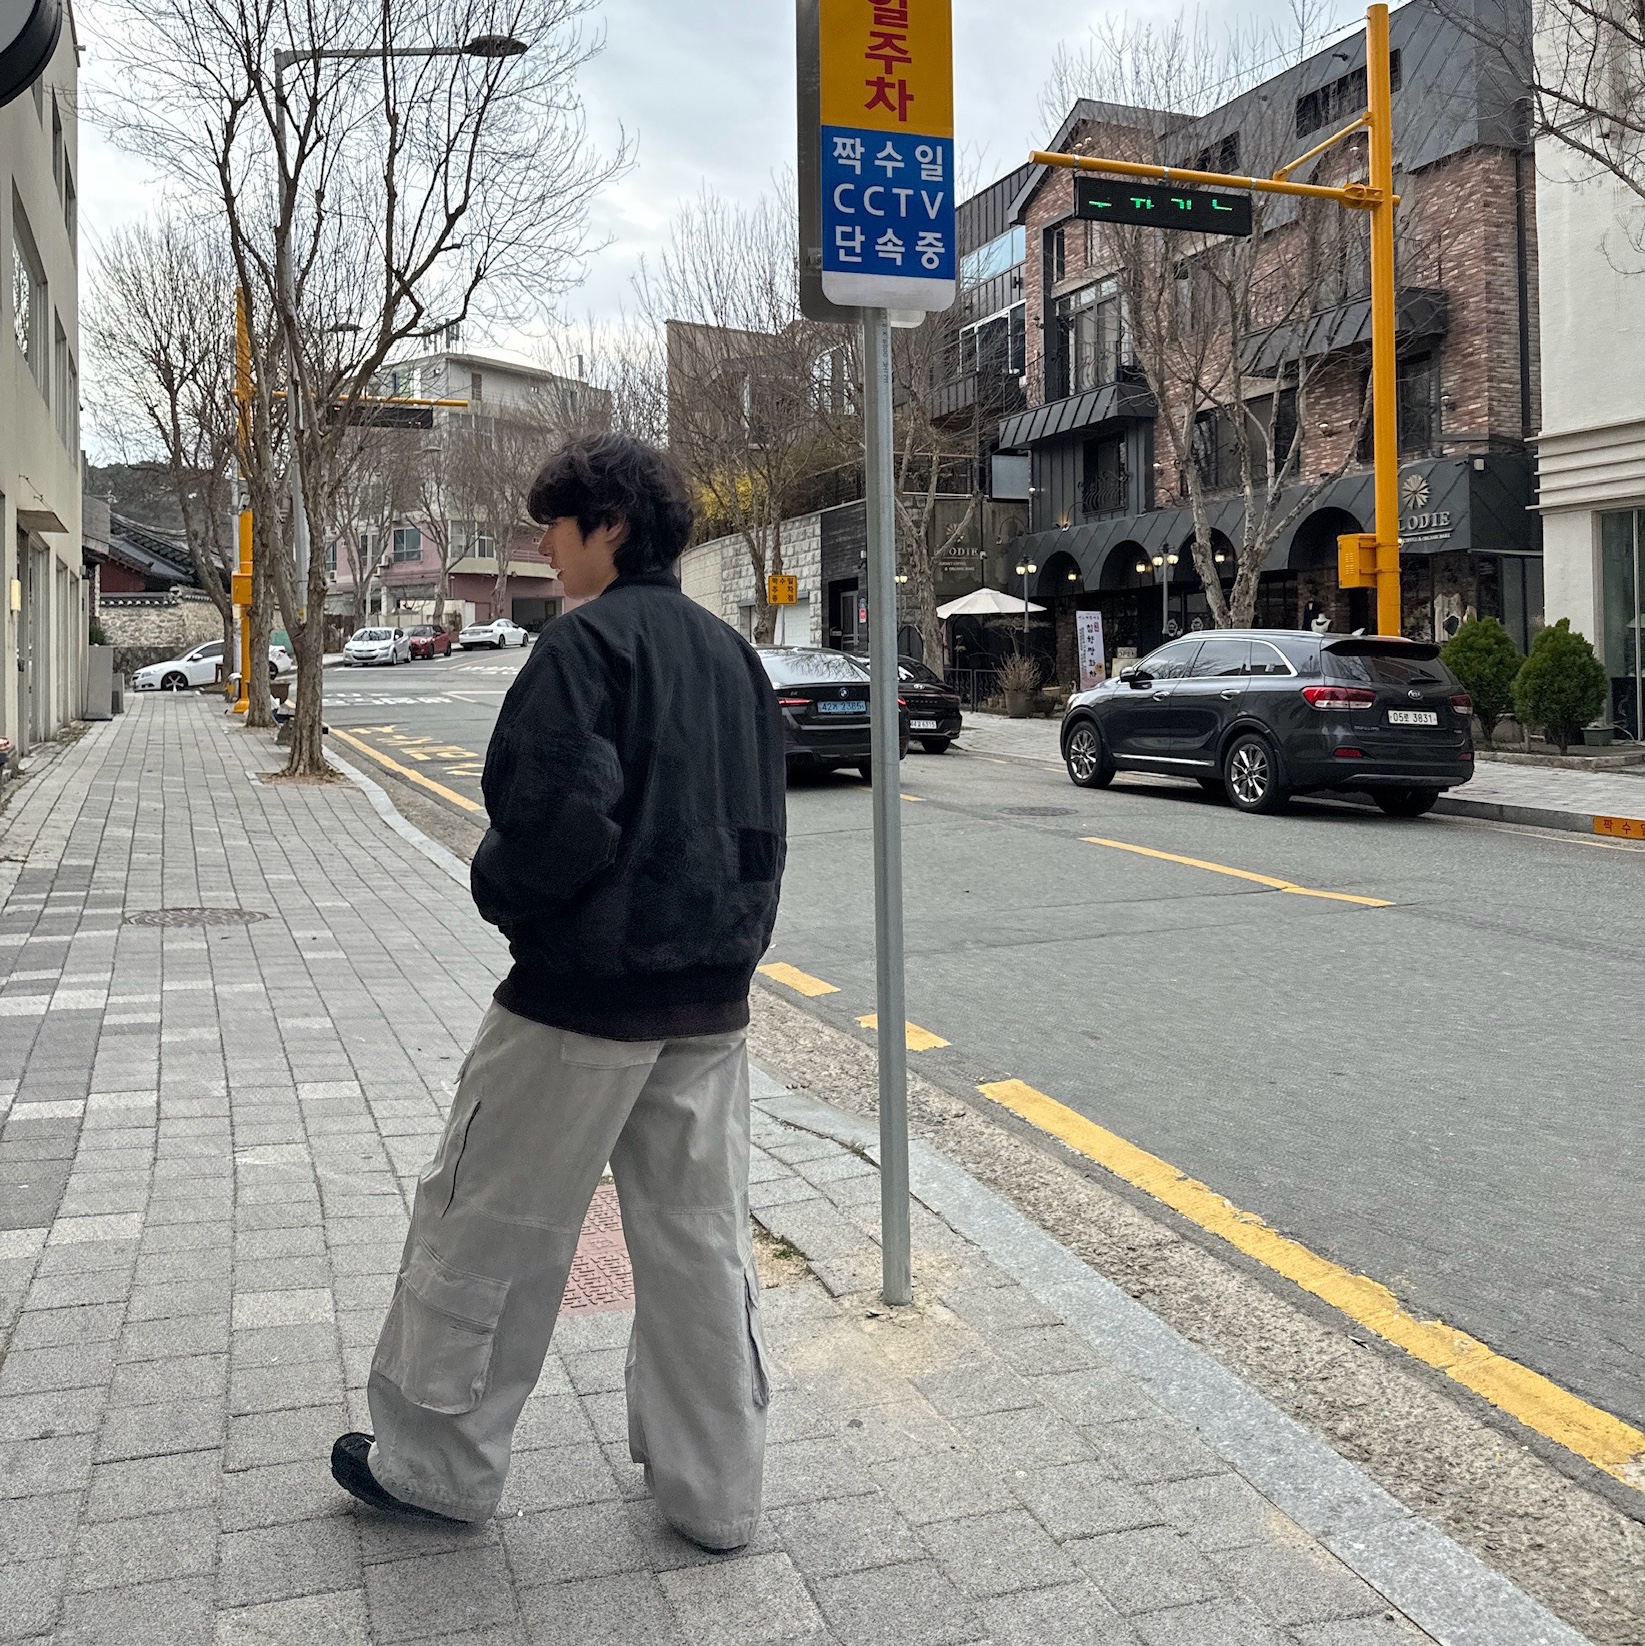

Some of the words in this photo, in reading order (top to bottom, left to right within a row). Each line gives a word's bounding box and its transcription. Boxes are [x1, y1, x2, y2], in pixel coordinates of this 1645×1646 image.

[832, 136, 944, 182] 짝수일
[833, 183, 945, 220] CCTV
[835, 225, 946, 270] 단속중
[1412, 713, 1433, 723] 3831
